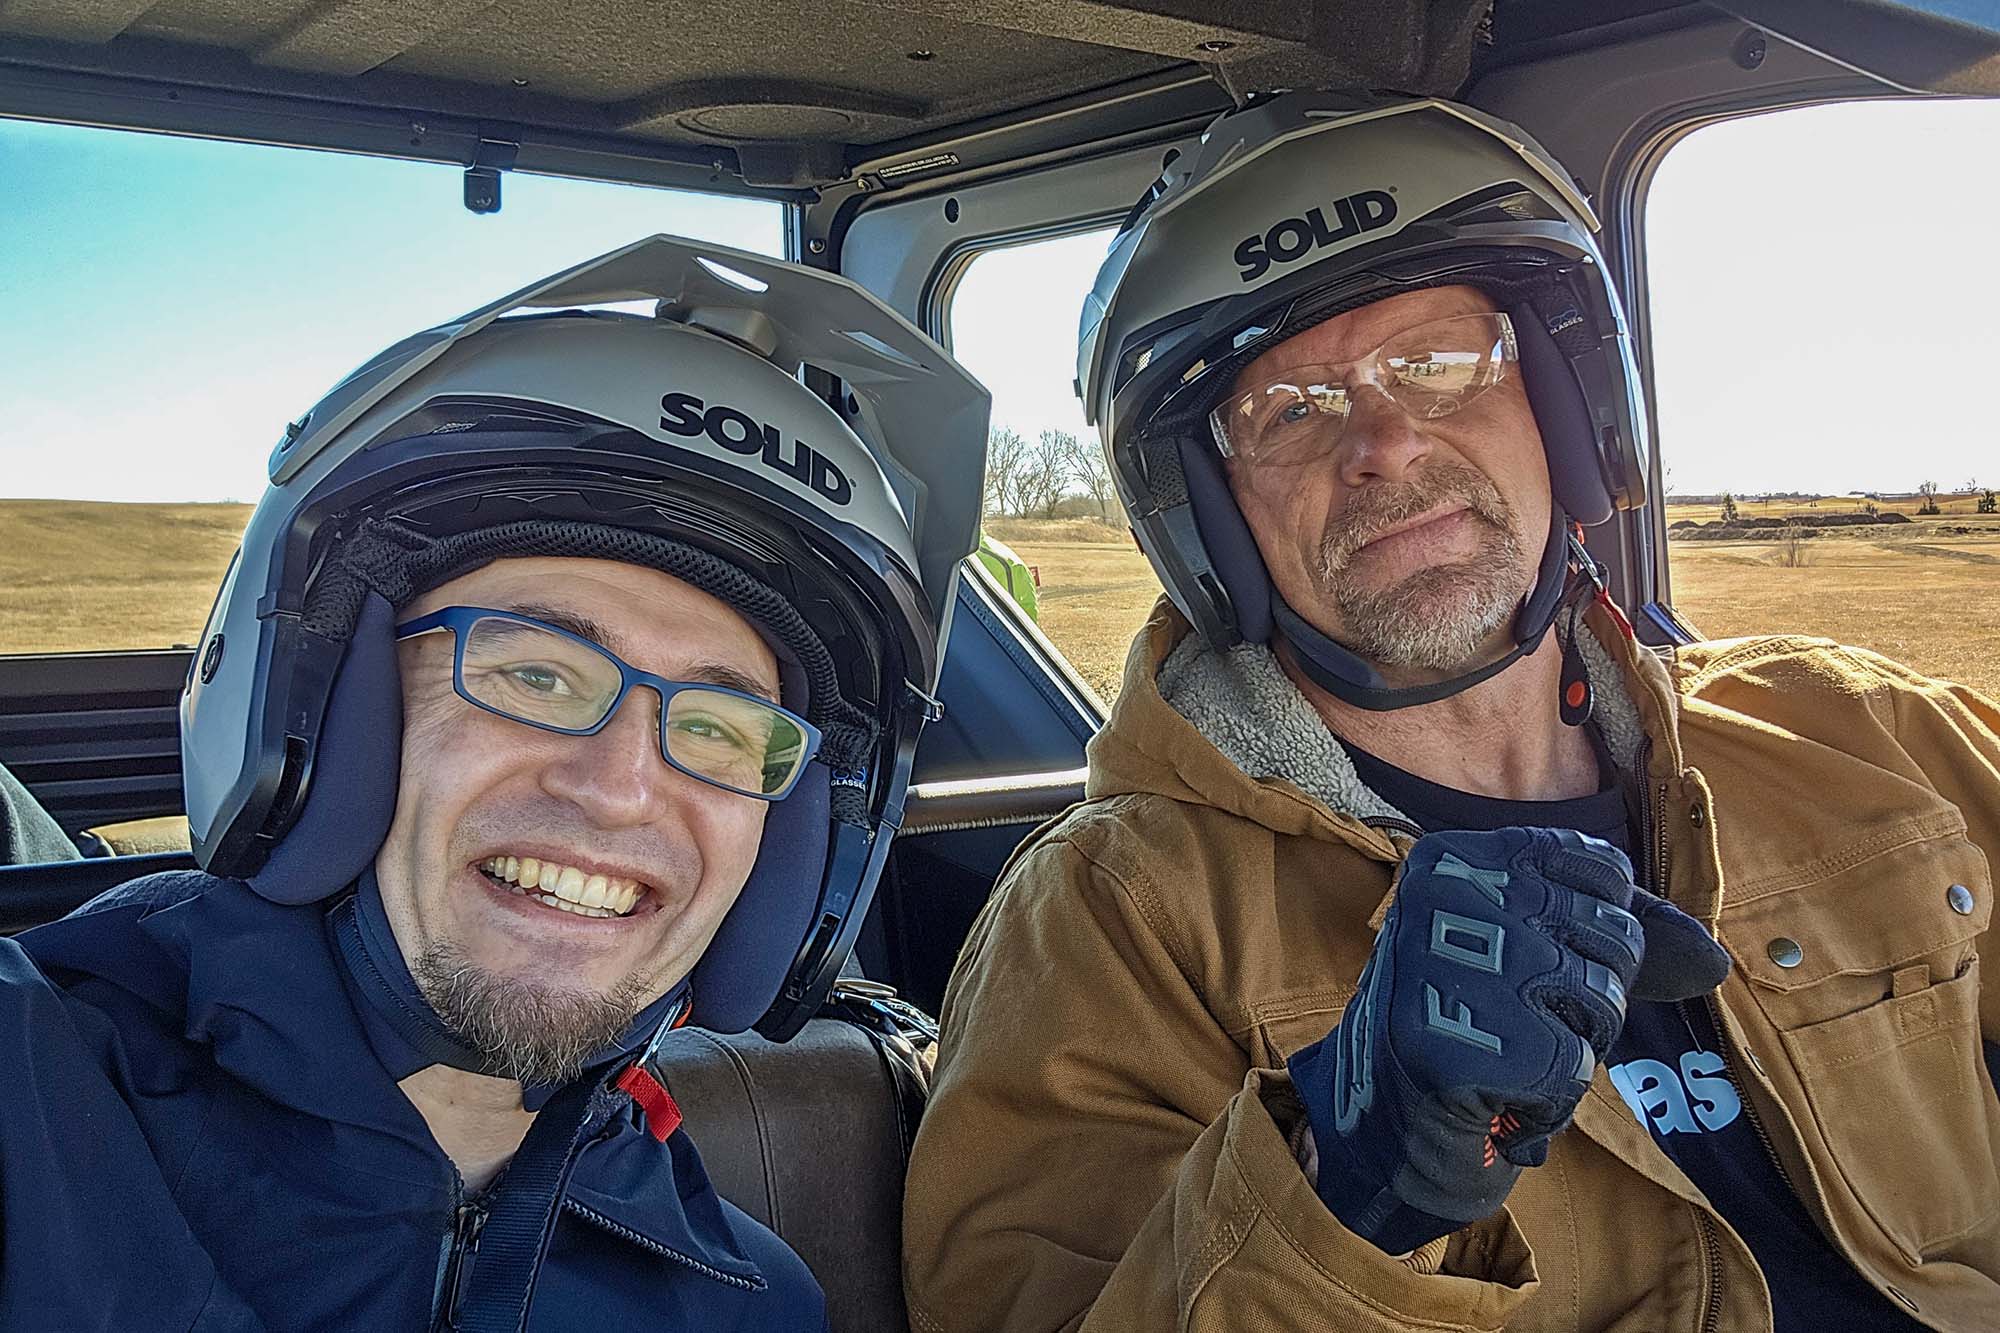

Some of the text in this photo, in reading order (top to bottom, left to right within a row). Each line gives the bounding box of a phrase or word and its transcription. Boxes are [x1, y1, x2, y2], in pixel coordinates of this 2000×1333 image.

[1234, 190, 1398, 282] SOLID
[1549, 316, 1584, 335] GLASSES
[660, 392, 852, 506] SOLID
[830, 779, 866, 793] GLASSE
[1423, 852, 1510, 1056] FOX
